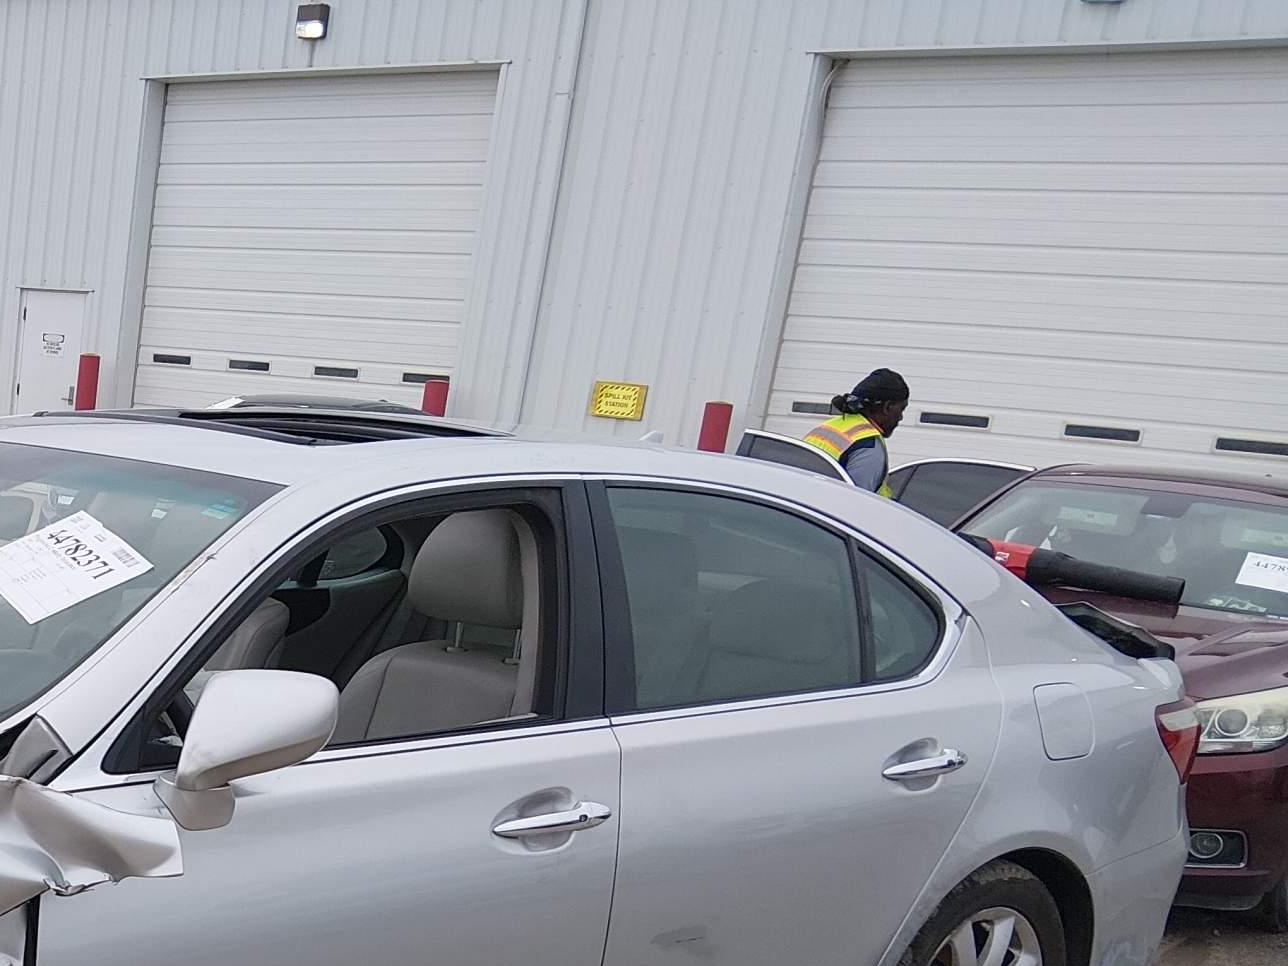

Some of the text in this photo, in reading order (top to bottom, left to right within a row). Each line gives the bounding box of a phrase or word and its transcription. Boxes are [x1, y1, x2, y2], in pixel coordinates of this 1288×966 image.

[604, 400, 629, 408] STATION
[47, 529, 115, 579] 44782371
[1253, 561, 1288, 571] 4478
